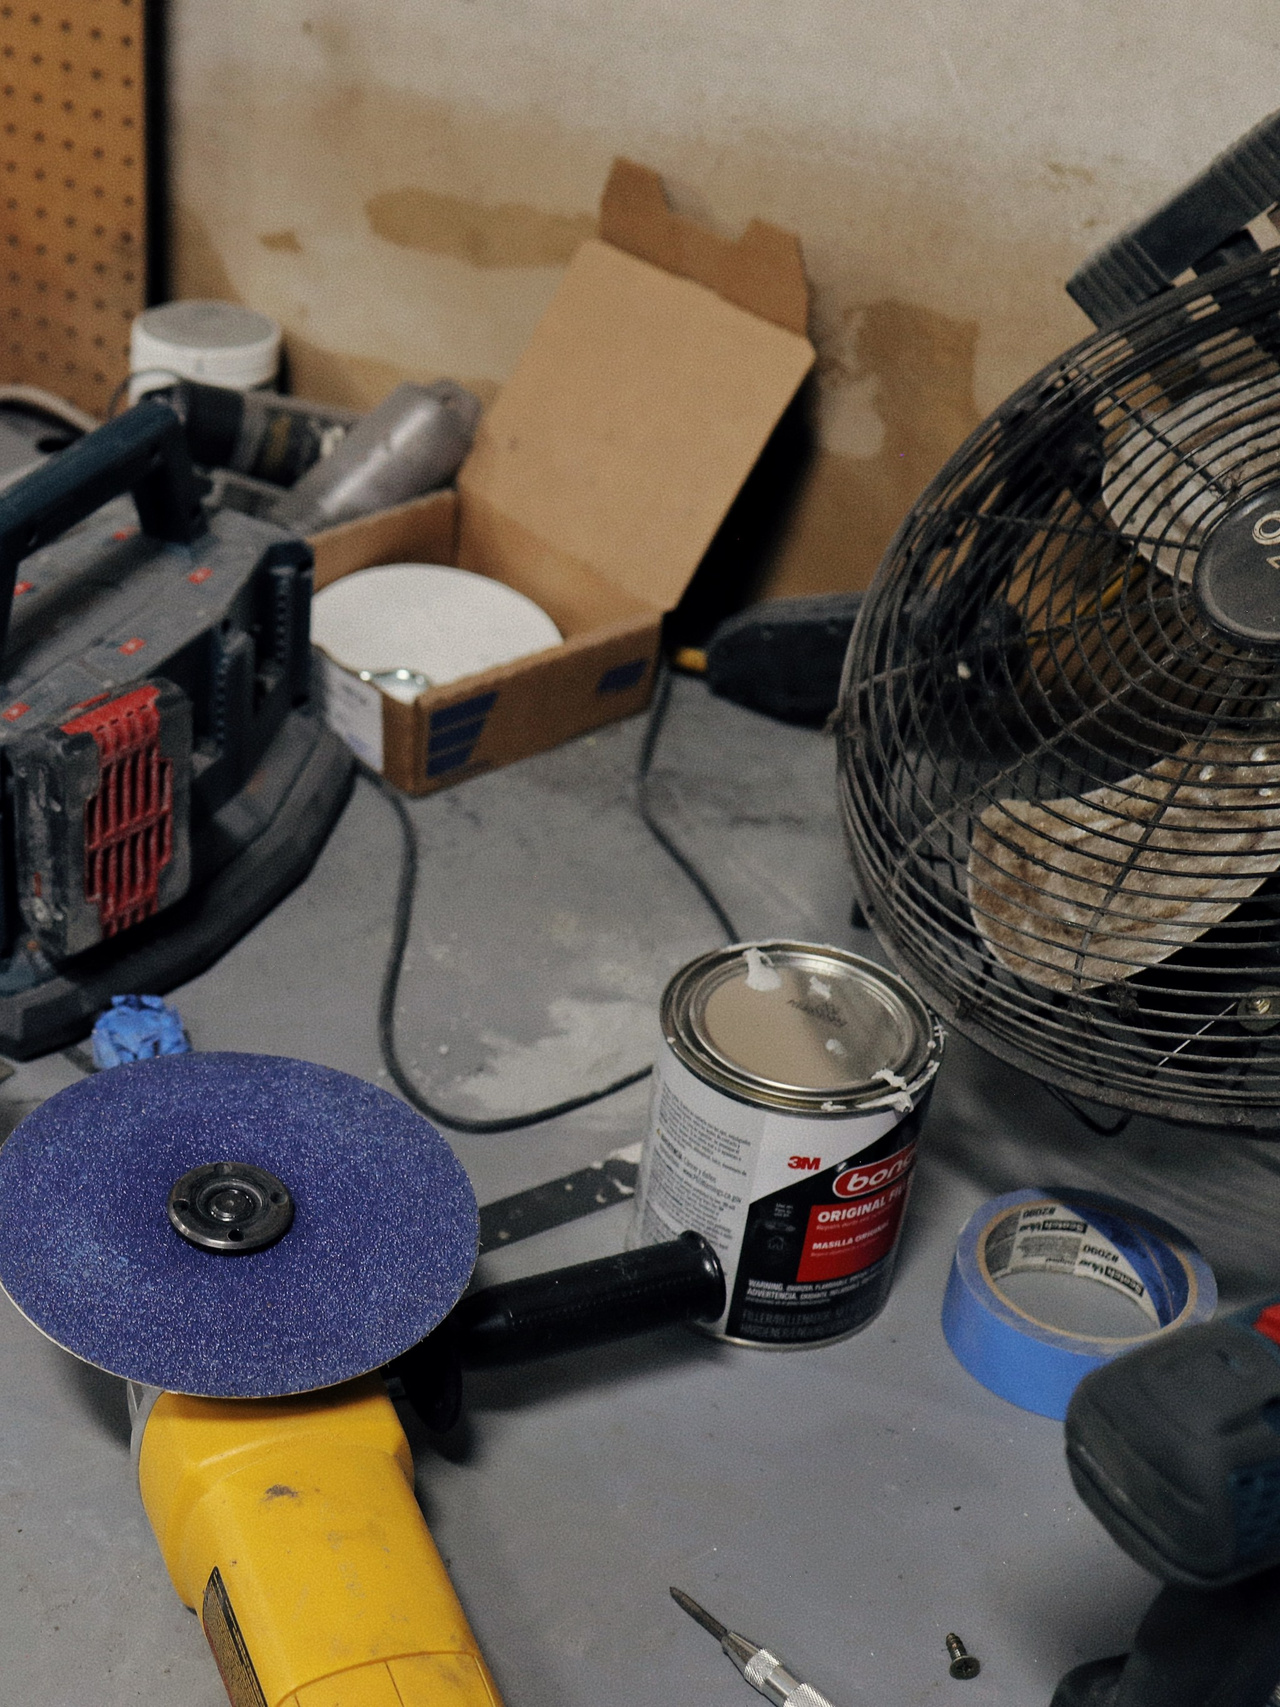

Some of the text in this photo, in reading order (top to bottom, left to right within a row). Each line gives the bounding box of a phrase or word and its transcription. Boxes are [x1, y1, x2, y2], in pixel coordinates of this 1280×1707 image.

[787, 1155, 821, 1170] 3M
[817, 1196, 886, 1223] ORIGINAL
[812, 1237, 853, 1251] MASILLA
[1082, 1244, 1119, 1264] #2090
